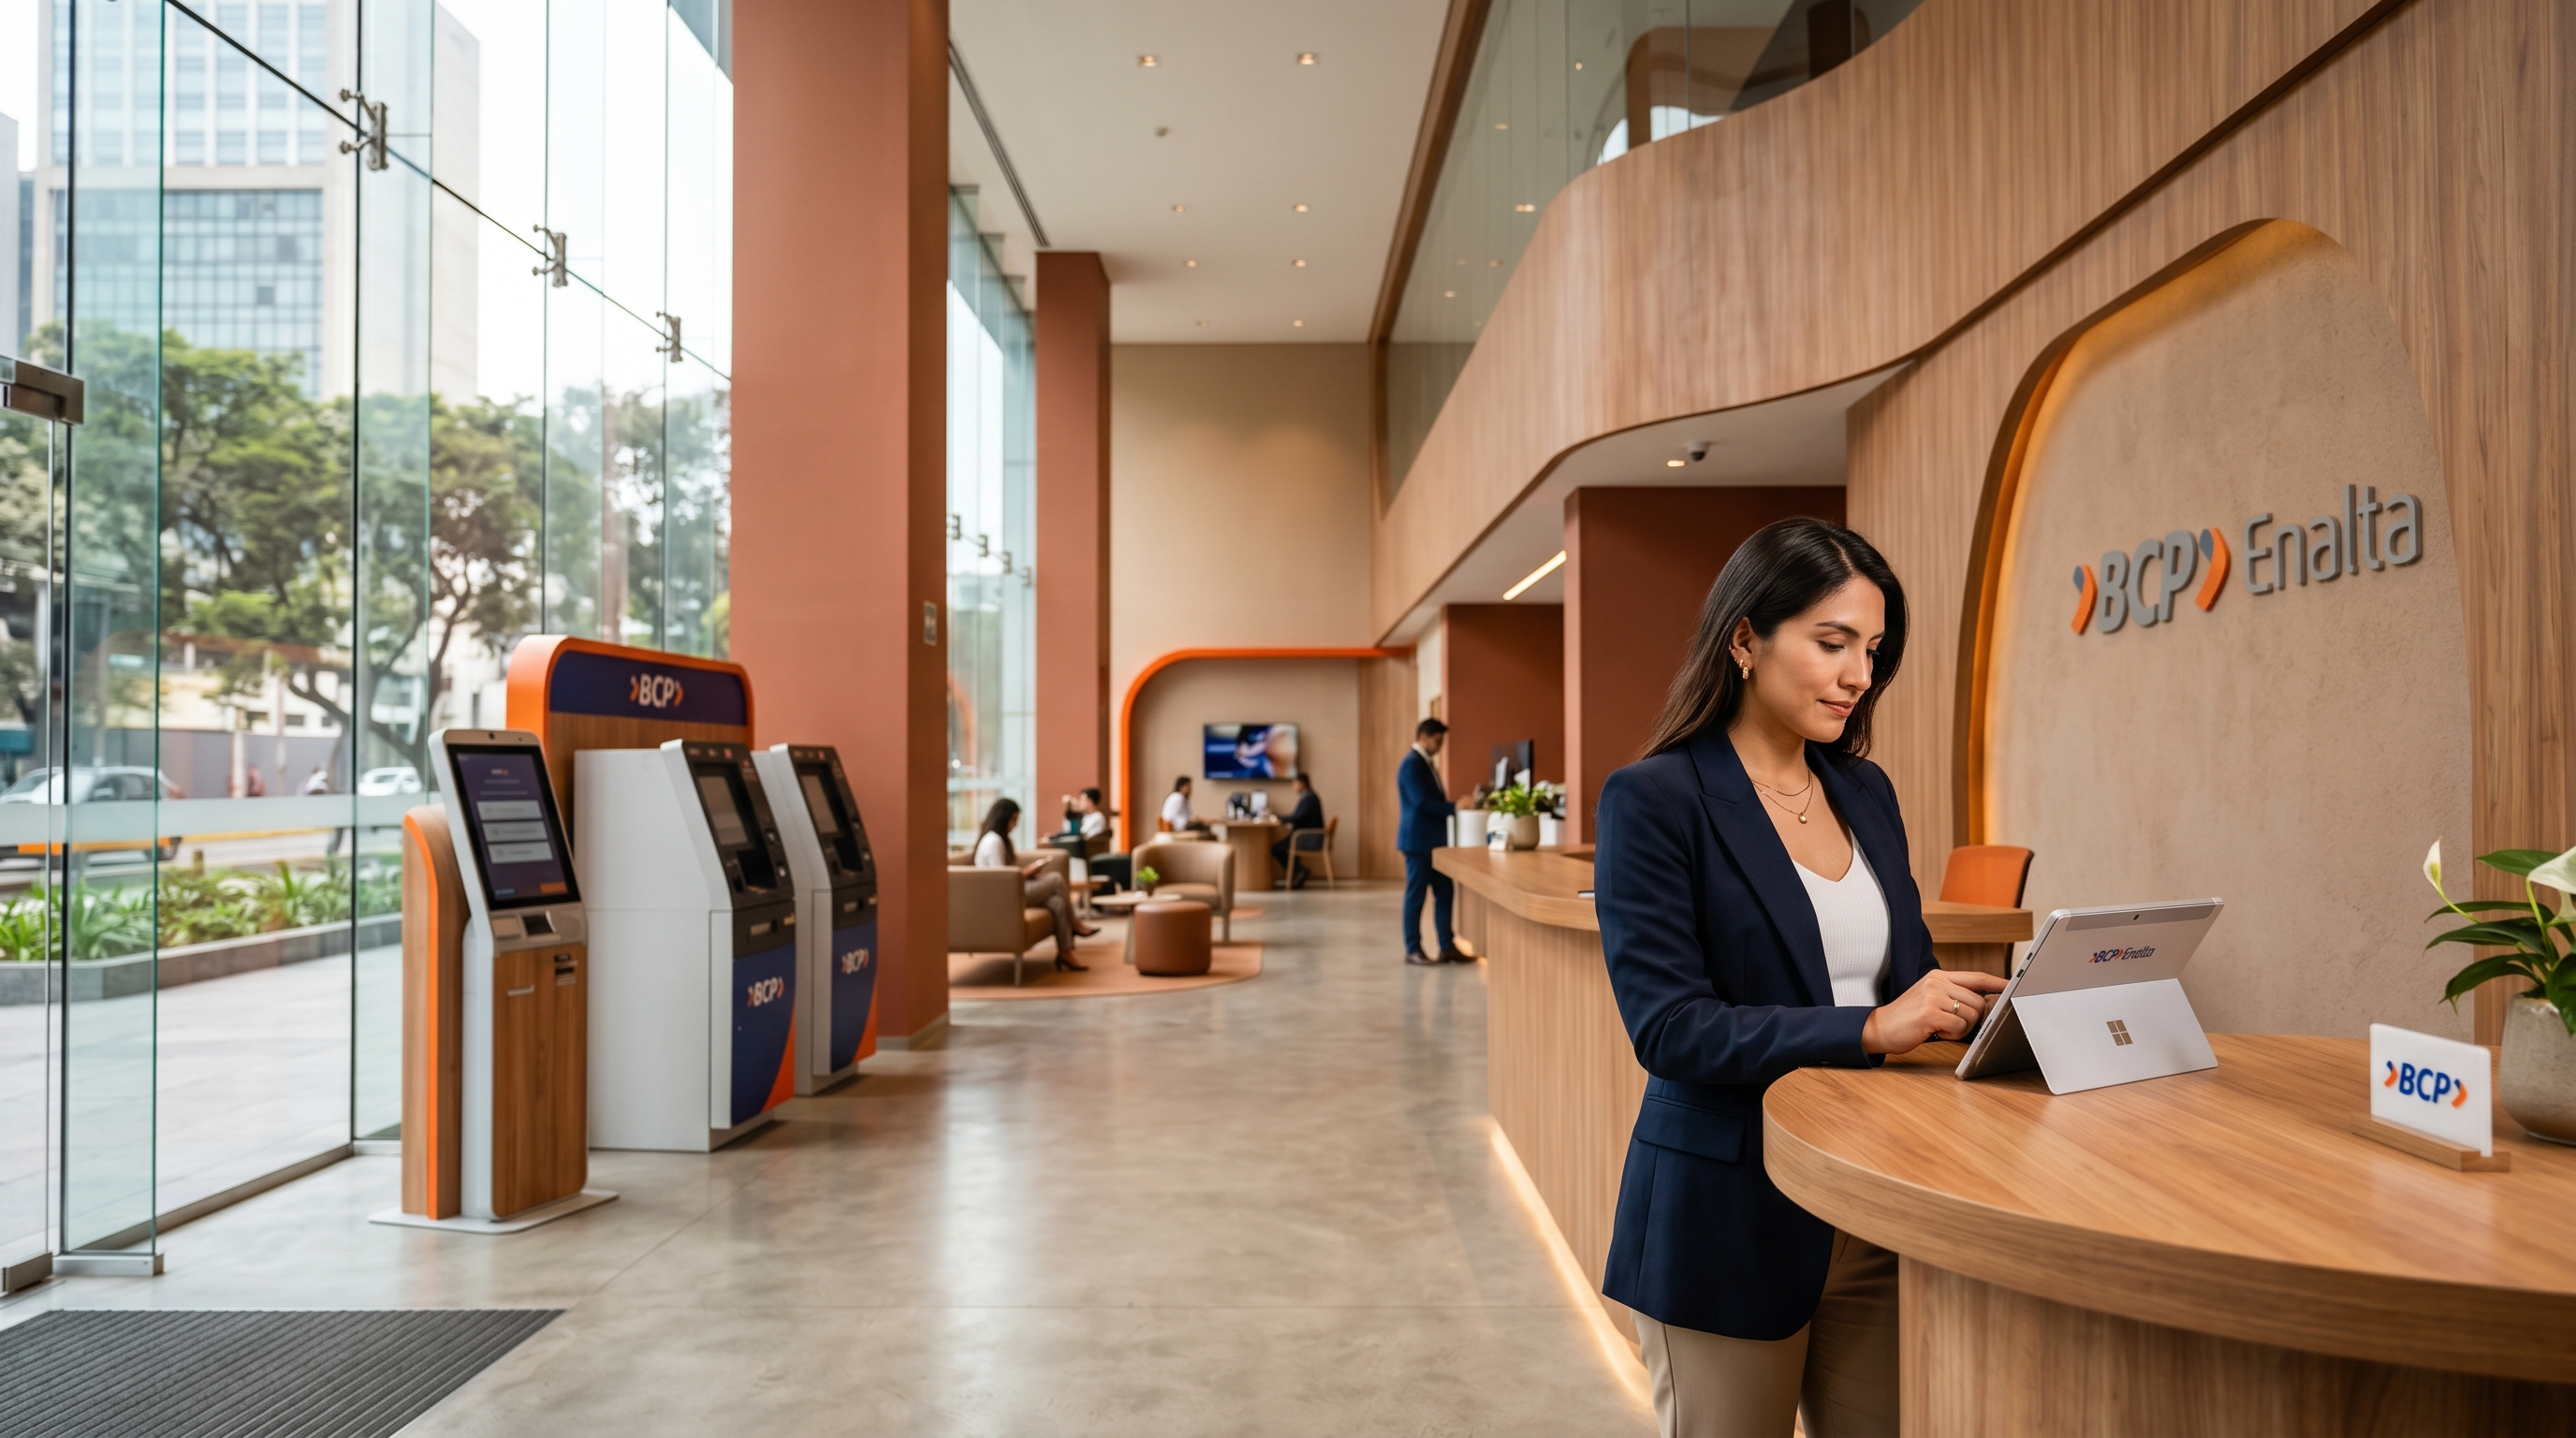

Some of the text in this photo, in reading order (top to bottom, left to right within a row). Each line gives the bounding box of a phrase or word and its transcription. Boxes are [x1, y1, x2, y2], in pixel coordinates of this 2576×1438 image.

[2096, 483, 2423, 634] BCP Enalta
[637, 673, 675, 708] BCP
[2094, 948, 2120, 963] BCP
[753, 976, 779, 1007] BCP
[2398, 1062, 2451, 1104] BCP
